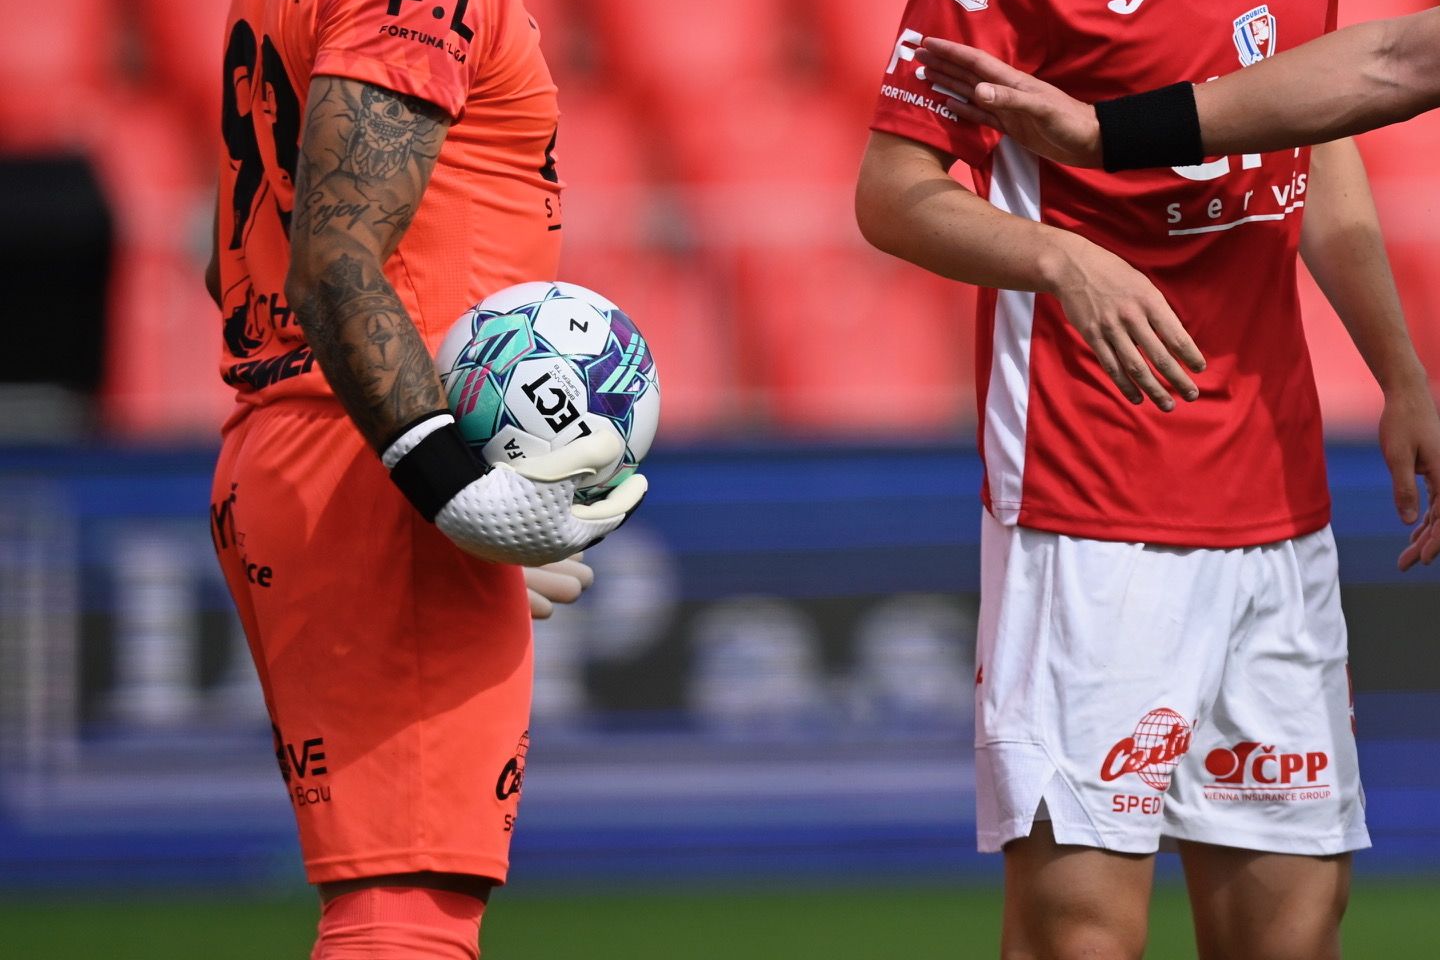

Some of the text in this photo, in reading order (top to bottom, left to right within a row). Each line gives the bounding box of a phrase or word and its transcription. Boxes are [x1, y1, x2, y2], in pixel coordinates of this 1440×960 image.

[1235, 6, 1267, 28] PARDUBICE
[521, 372, 592, 443] LECT
[1252, 745, 1329, 785] ČPP
[1203, 791, 1331, 801] VIENNA INSURANCE GROUP
